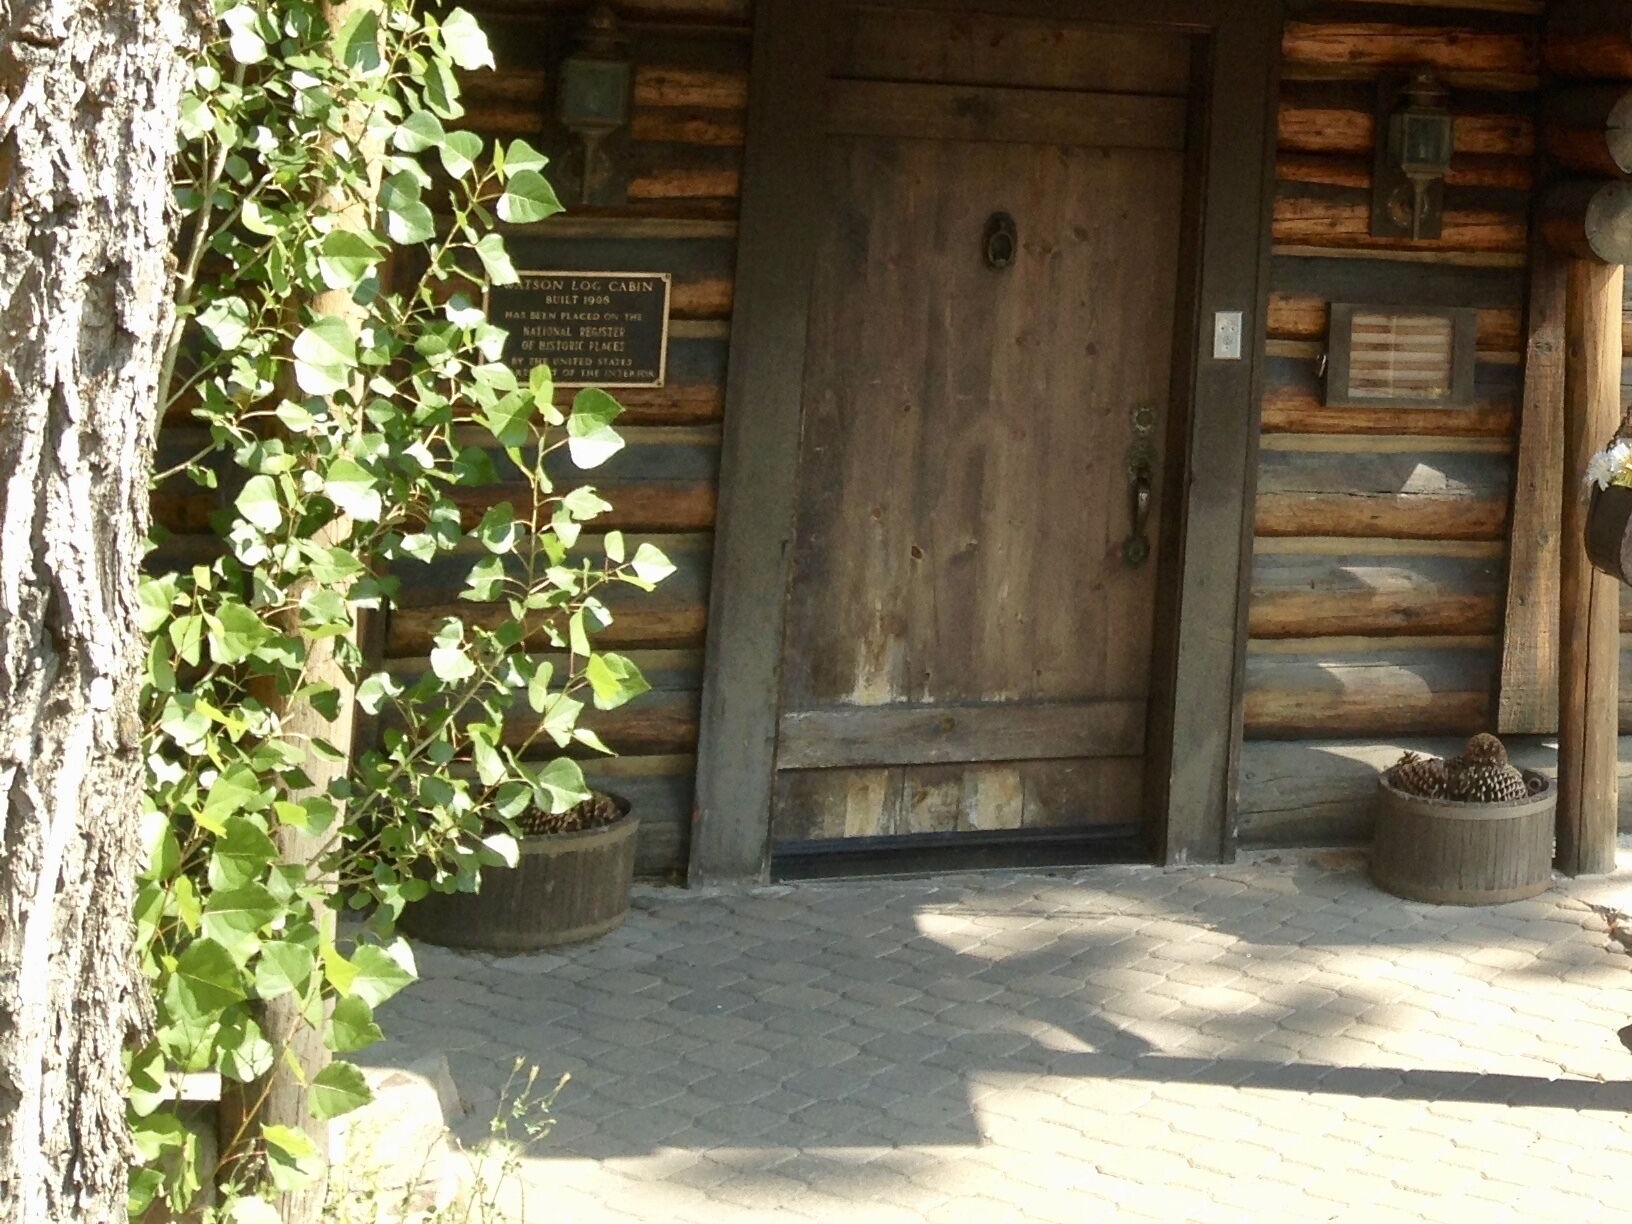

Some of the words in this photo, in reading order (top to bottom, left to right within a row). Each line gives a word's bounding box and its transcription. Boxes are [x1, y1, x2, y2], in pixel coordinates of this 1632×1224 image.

[571, 280, 601, 291] LOG
[608, 281, 653, 292] CABIN
[545, 295, 579, 305] BUILT
[530, 311, 557, 321] BEEN
[560, 312, 600, 321] PLACED
[603, 312, 619, 321] ON
[624, 313, 643, 321] THE
[523, 326, 572, 337] NATIONAL
[579, 326, 626, 338] REGISTER
[521, 340, 534, 351] OF
[538, 340, 583, 352] HISTORIC
[589, 341, 625, 352] PLACES
[553, 357, 593, 366] UNITED
[598, 357, 633, 367] STATES
[581, 369, 600, 377] THE
